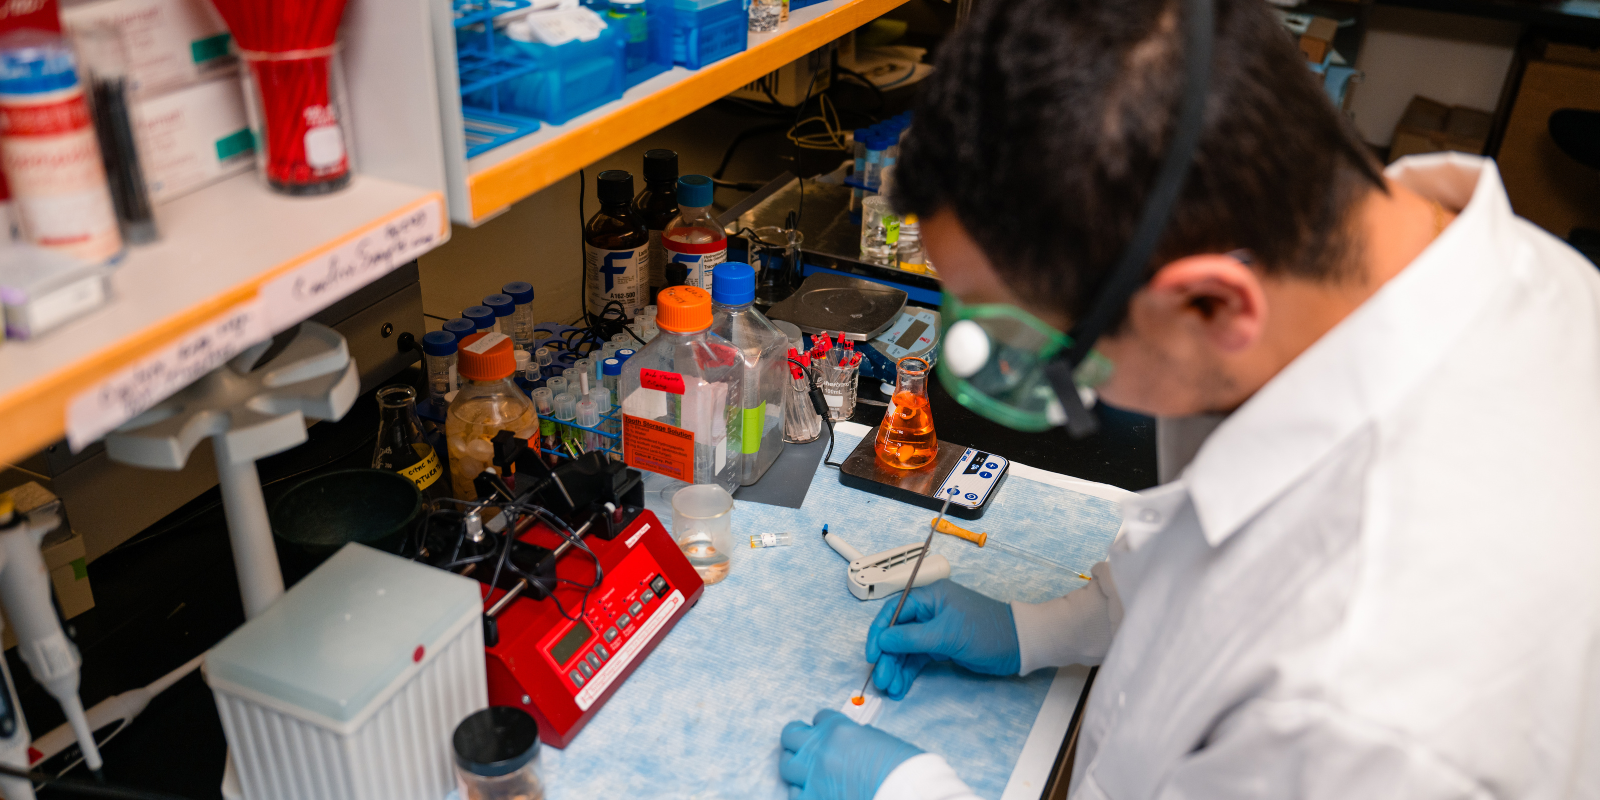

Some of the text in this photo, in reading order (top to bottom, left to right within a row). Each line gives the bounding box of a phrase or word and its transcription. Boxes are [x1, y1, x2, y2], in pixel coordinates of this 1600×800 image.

[625, 416, 692, 439] Tooth Storage Solution
